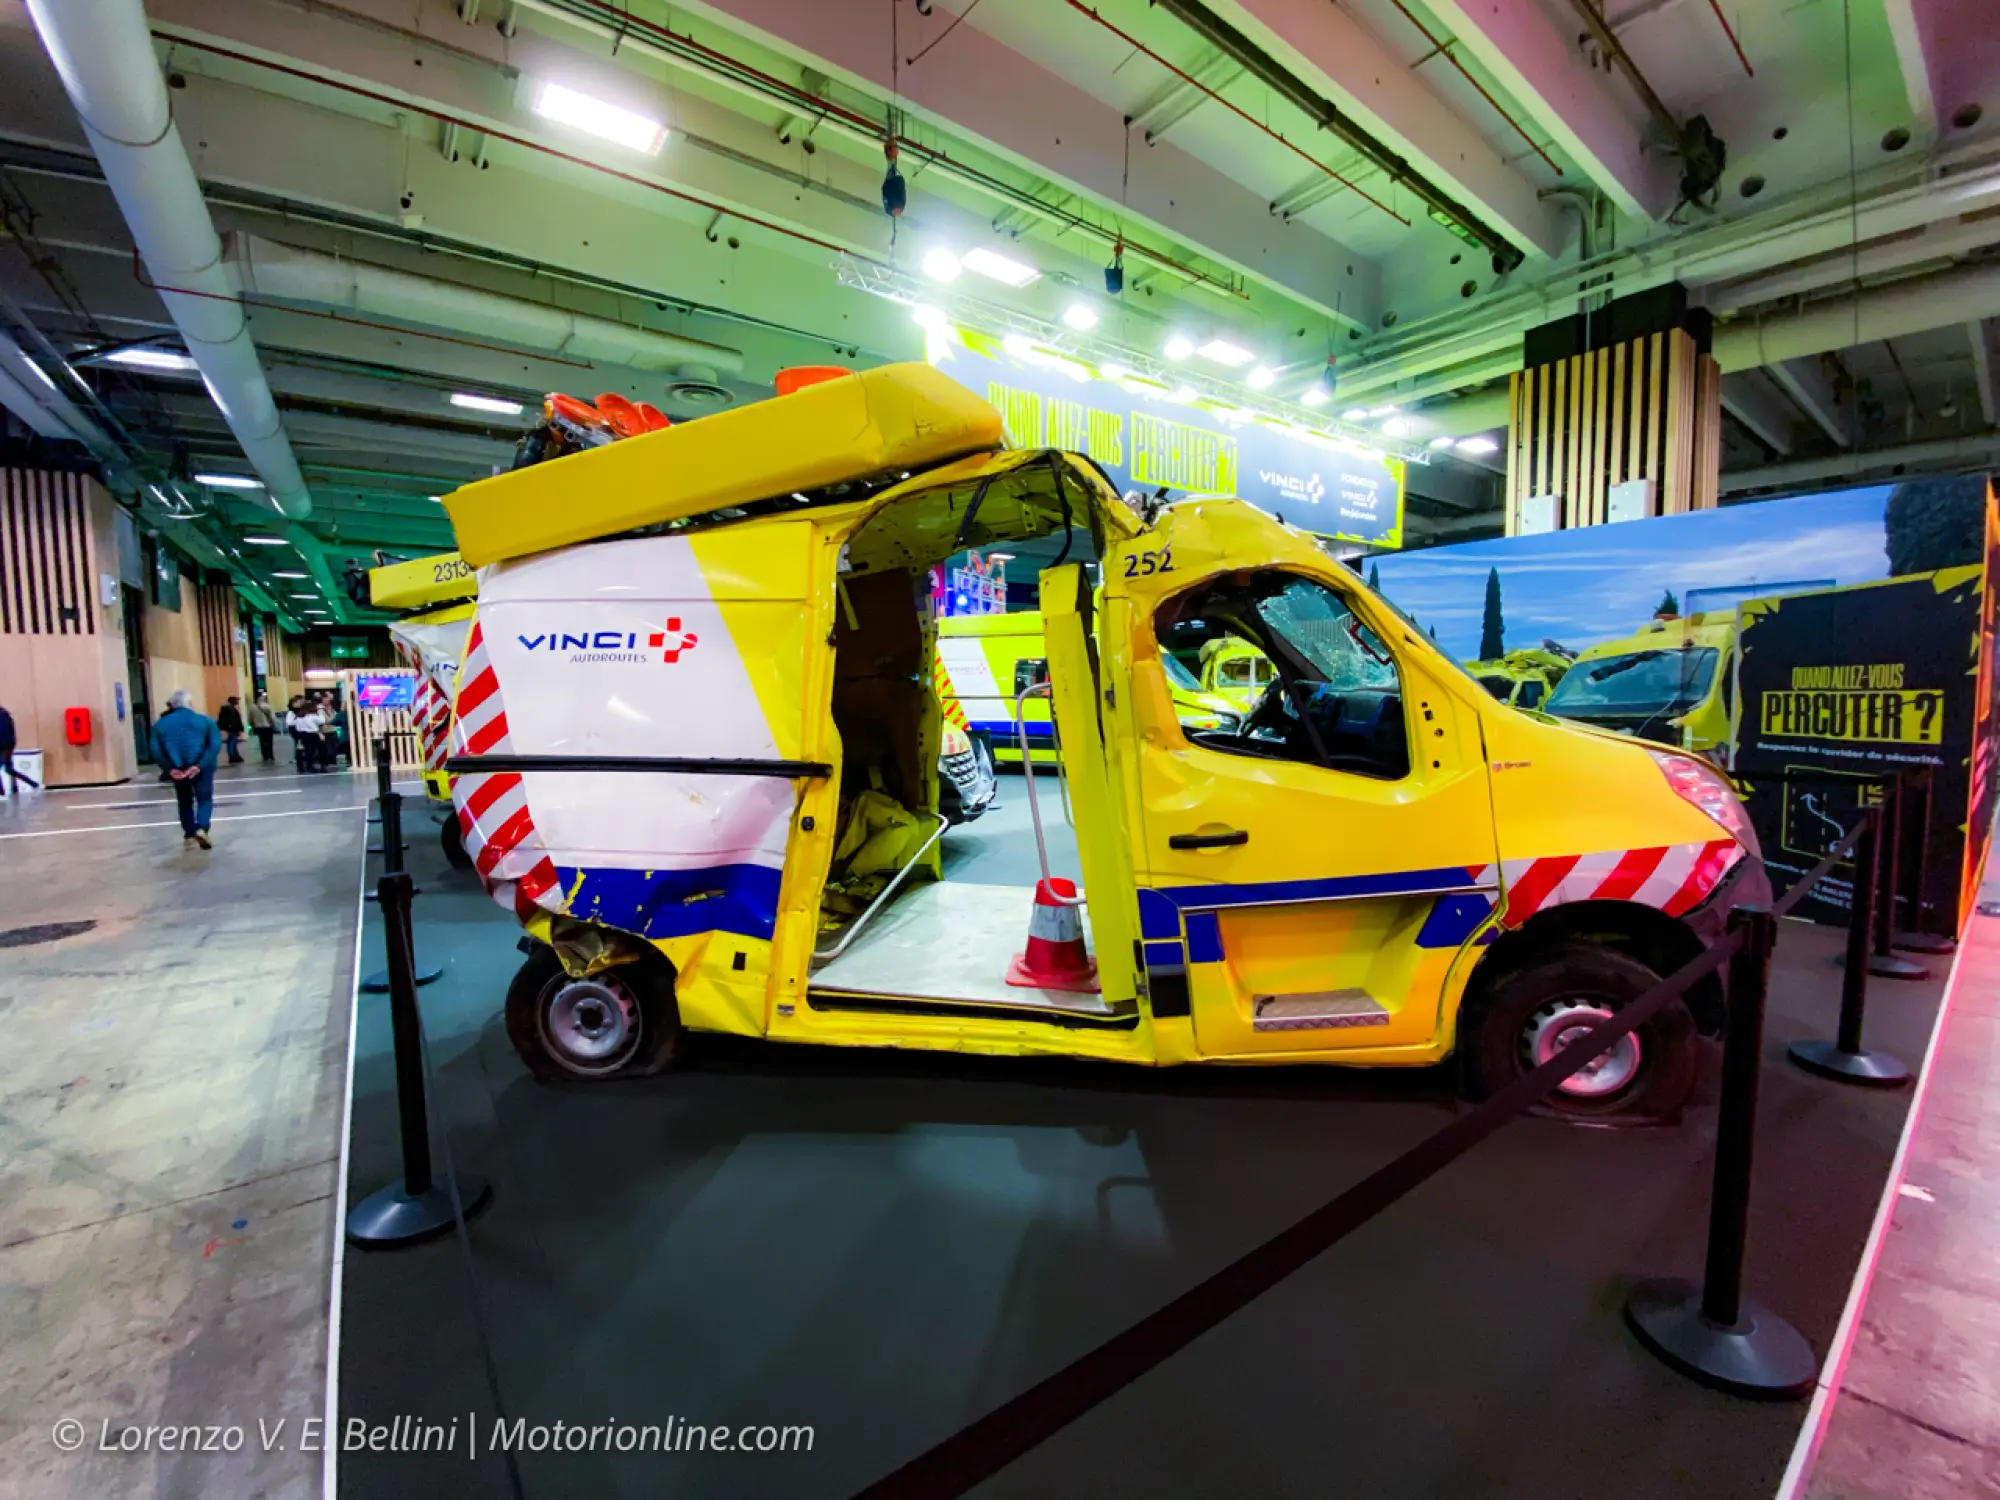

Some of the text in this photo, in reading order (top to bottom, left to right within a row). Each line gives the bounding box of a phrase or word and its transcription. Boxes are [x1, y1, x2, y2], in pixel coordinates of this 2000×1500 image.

[1259, 470, 1304, 492] VINCI
[1125, 550, 1174, 578] 252
[518, 632, 636, 650] VINCI
[570, 653, 647, 664] AUTOROUTES
[1792, 664, 1904, 690] QUAND ALLEZ-VOUS
[1765, 693, 1938, 741] PERCUTER ?
